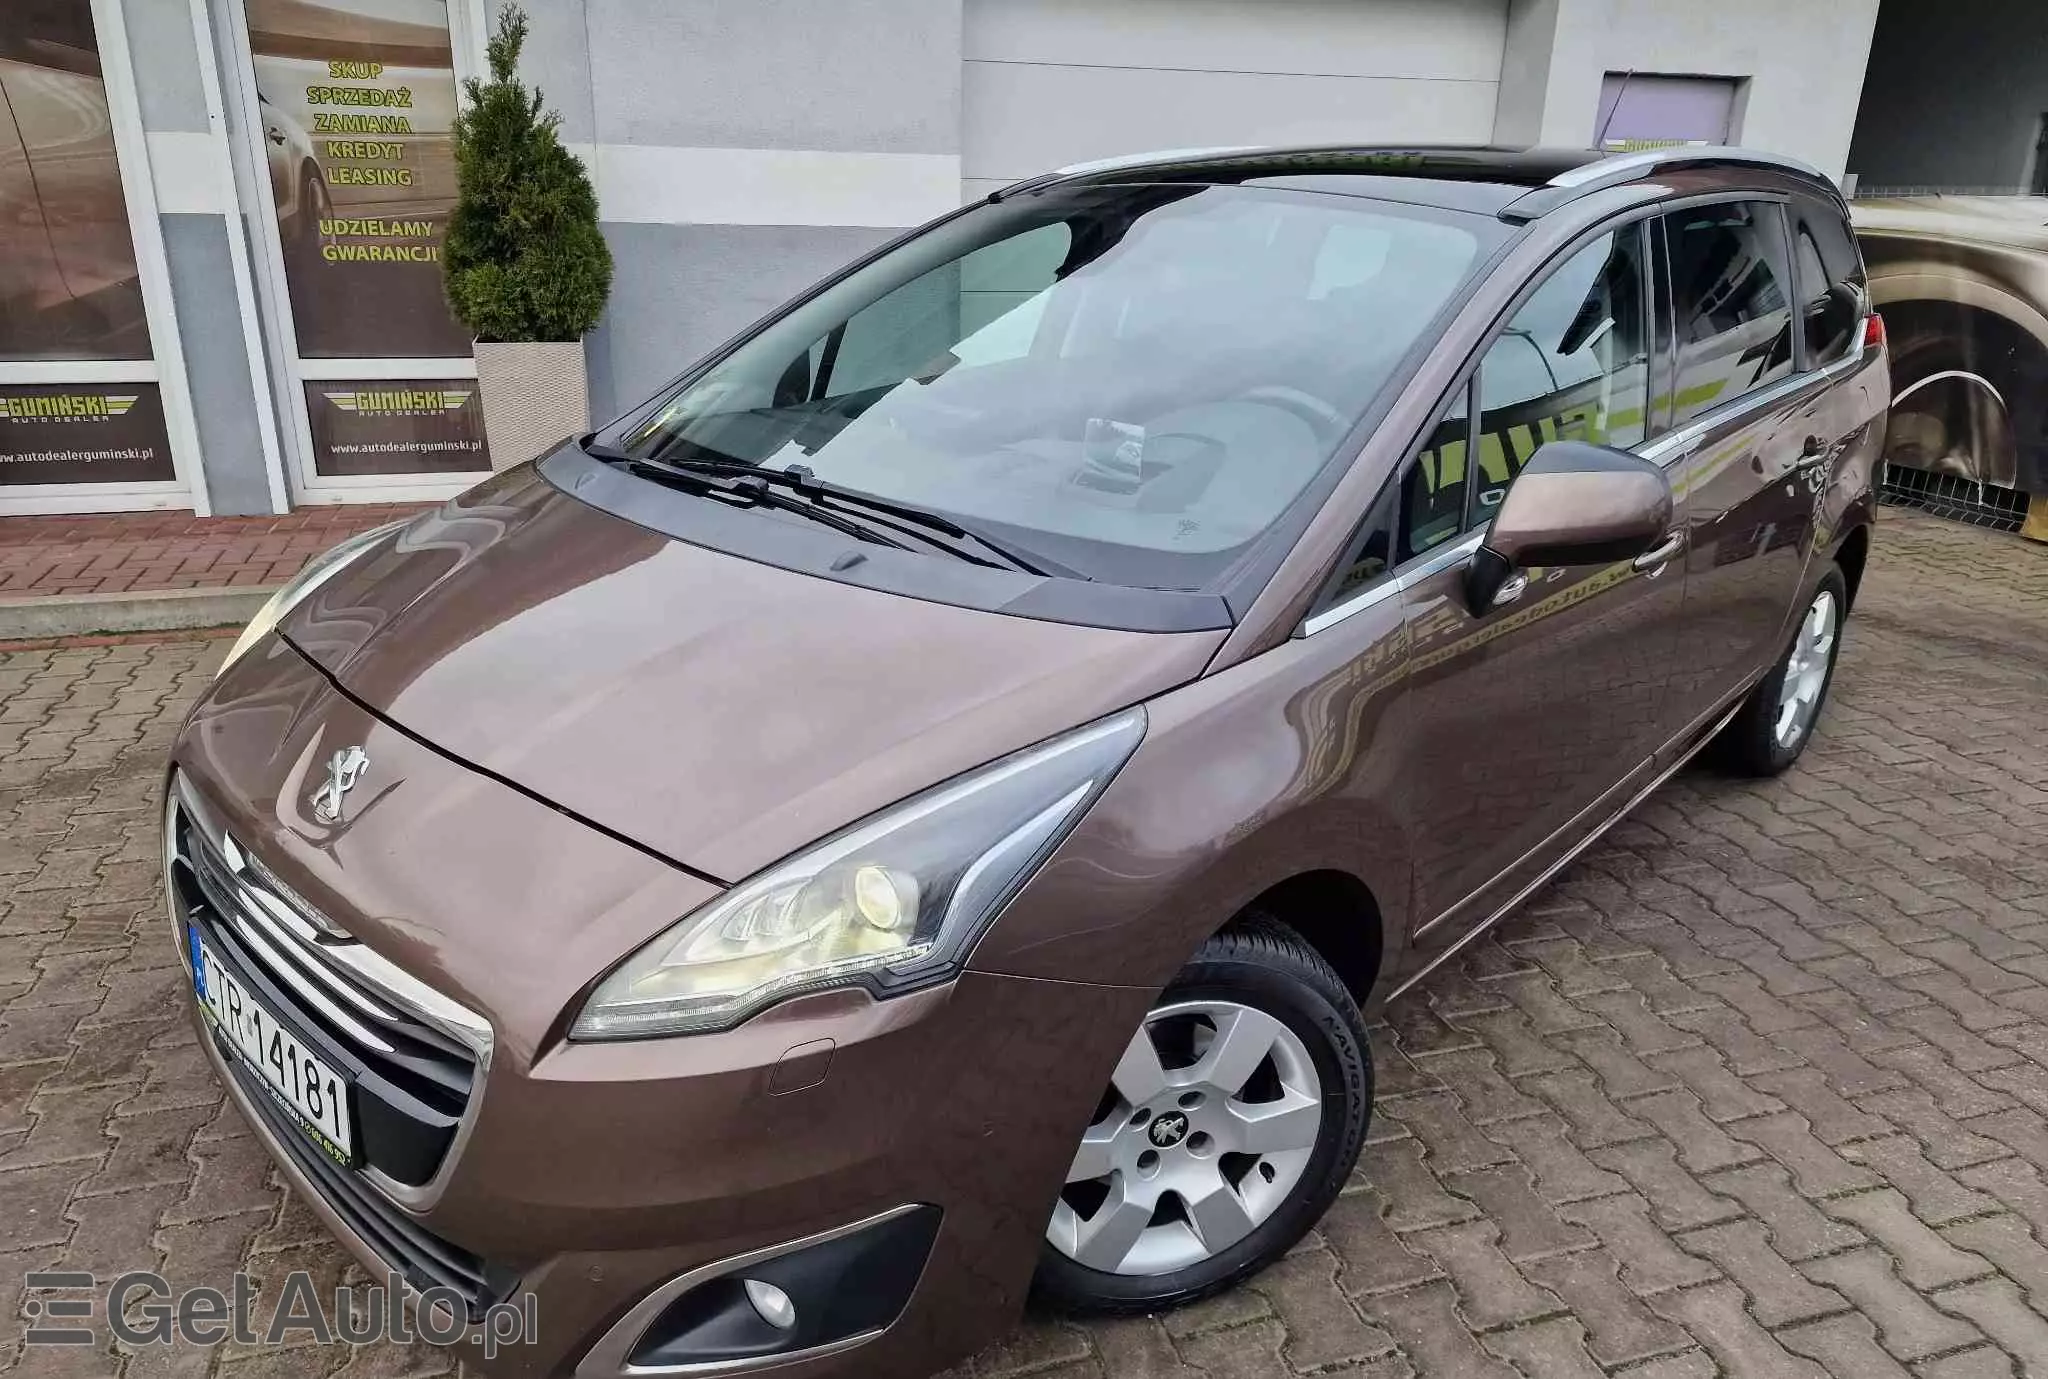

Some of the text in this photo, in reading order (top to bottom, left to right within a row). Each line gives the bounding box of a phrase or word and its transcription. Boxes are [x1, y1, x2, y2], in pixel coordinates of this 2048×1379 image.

[329, 61, 383, 79] SKUP
[307, 86, 413, 107] SPRZEDAŻ
[314, 114, 412, 133] ZAMIANA
[327, 141, 404, 160] KREDYT
[327, 168, 413, 186] LEASING
[319, 219, 433, 237] UDZIELAMY
[322, 245, 439, 262] GWARANCJI
[8, 394, 107, 417] GUMIŃSKI
[356, 388, 444, 410] GUMIŃSKI
[330, 439, 482, 456] www.autodealerguminski.pl
[202, 949, 245, 1045] CTR
[253, 1009, 341, 1139] 14181
